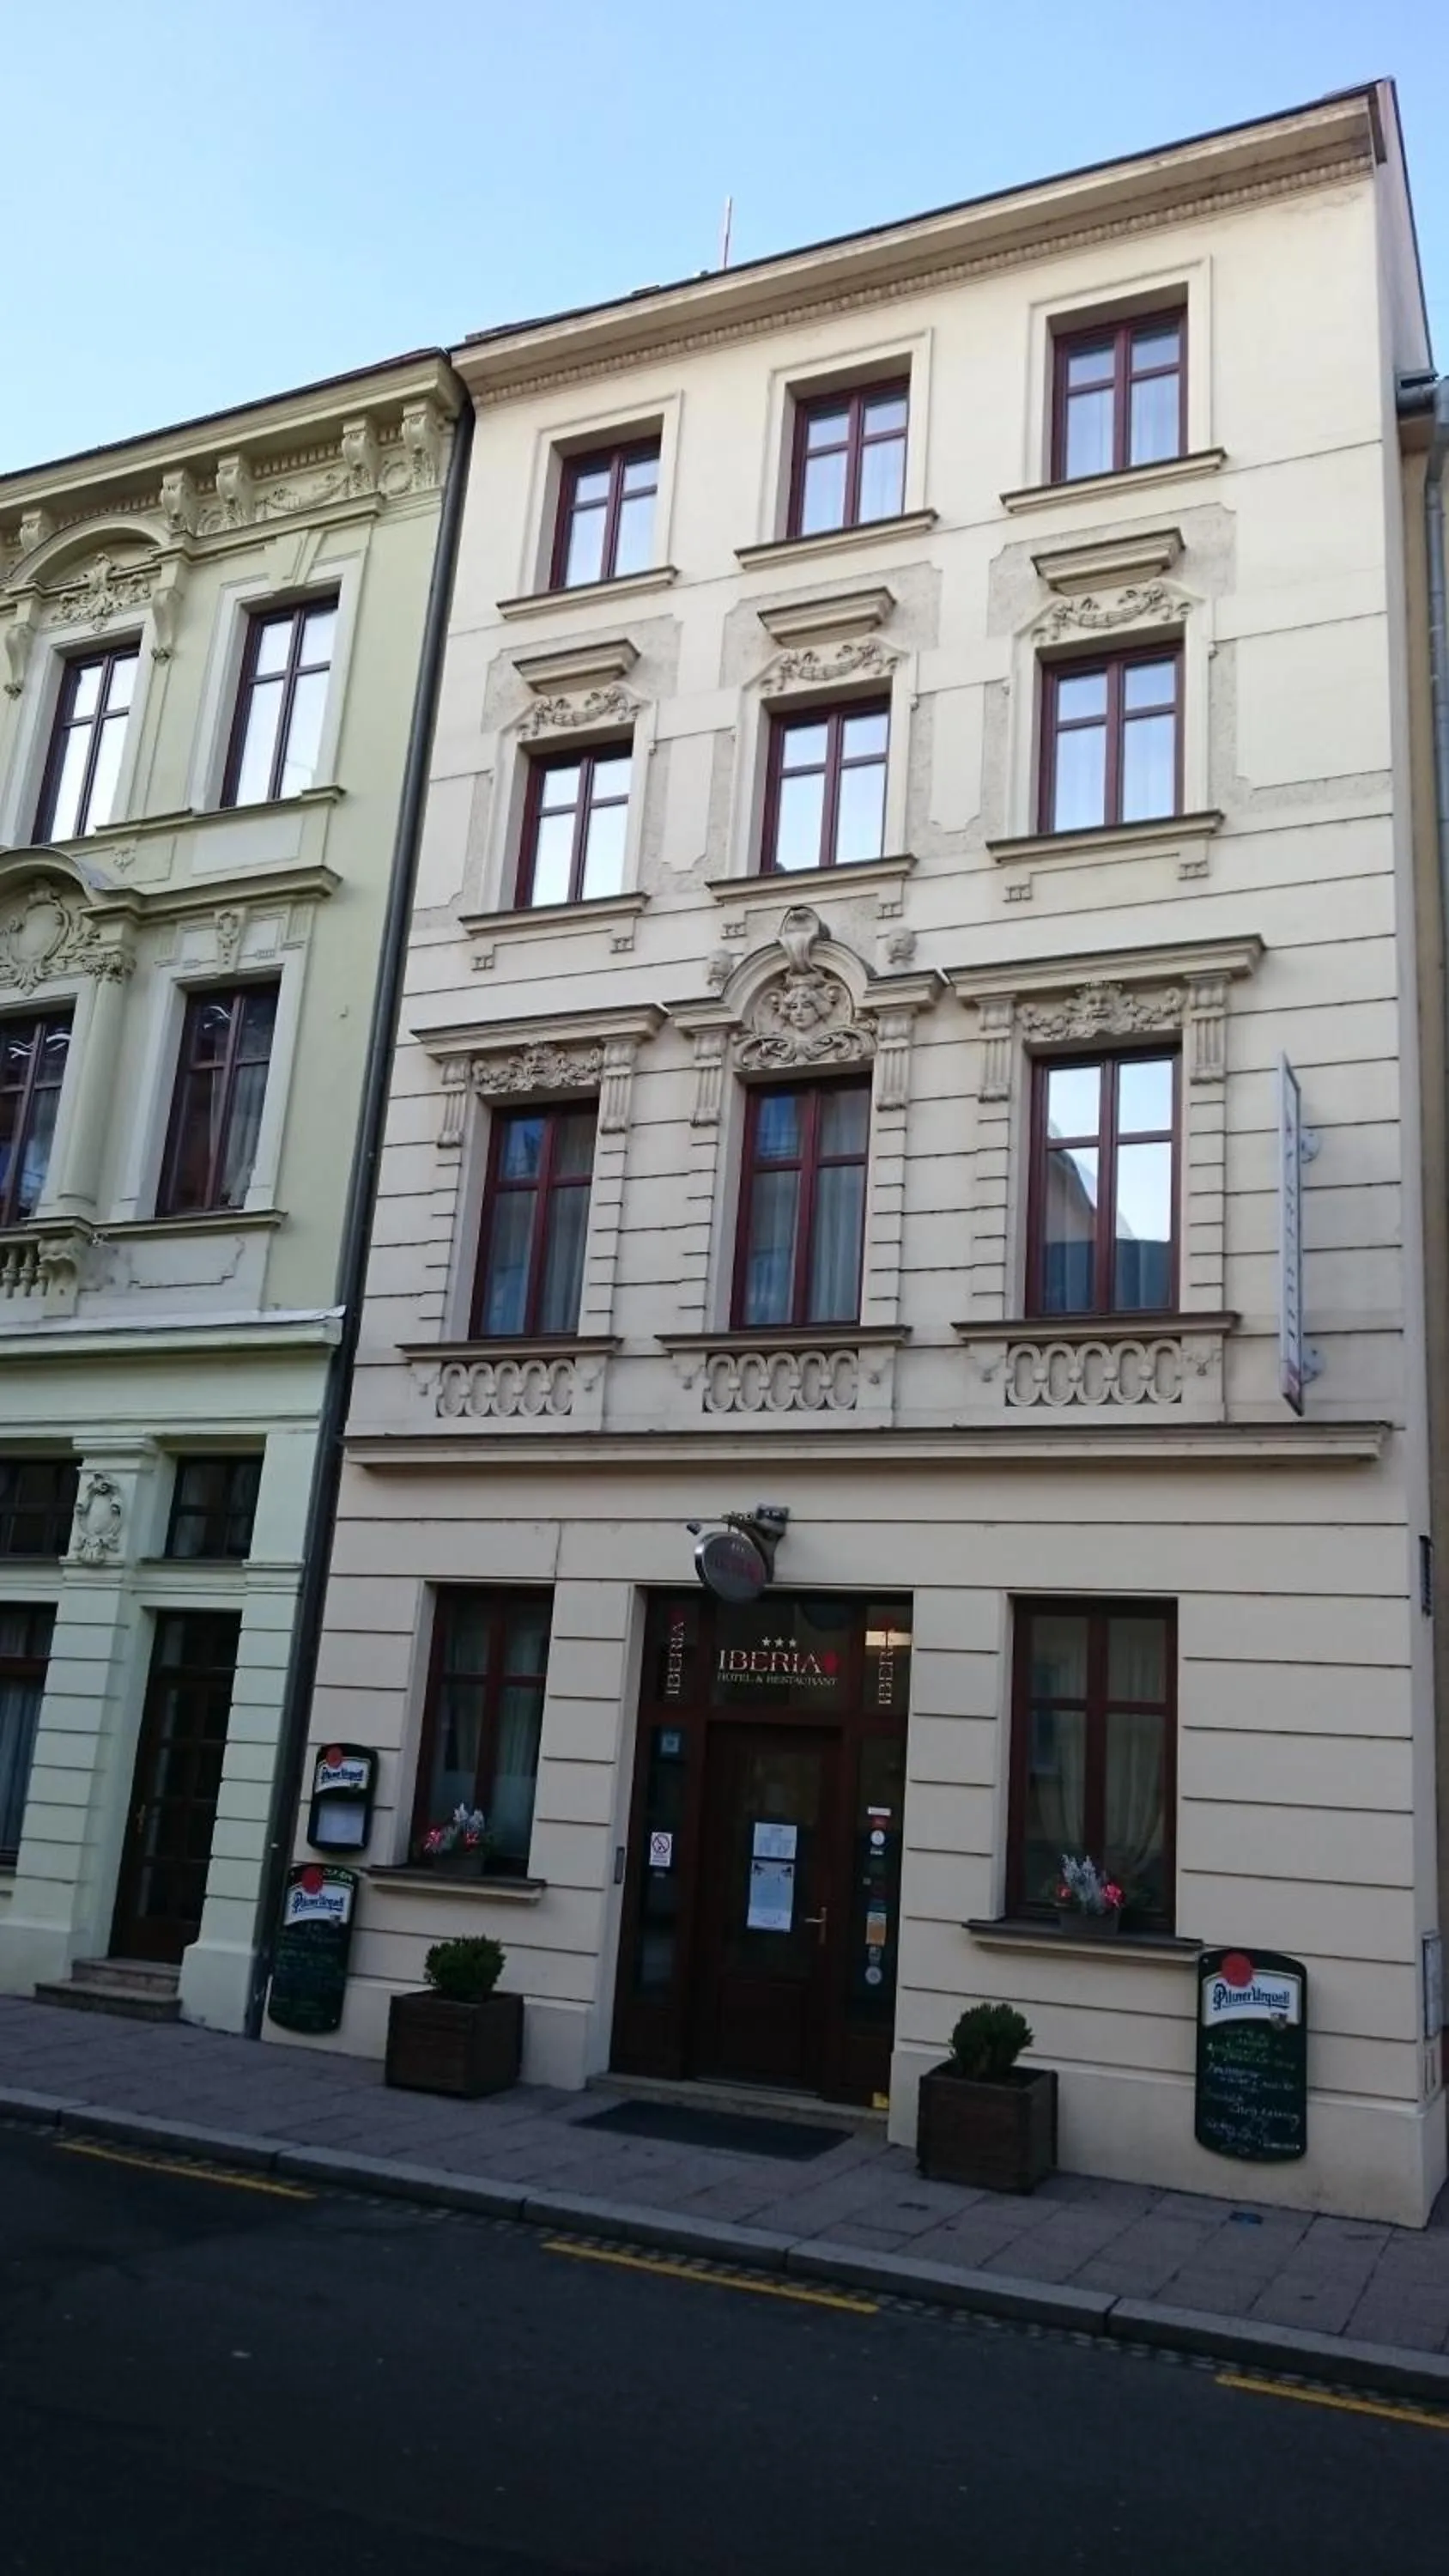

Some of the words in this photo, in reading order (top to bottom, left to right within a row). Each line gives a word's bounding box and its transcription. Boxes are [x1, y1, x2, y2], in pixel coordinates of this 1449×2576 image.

[718, 1649, 822, 1674] IBERIA
[717, 1672, 753, 1683] HOTEL
[766, 1675, 839, 1686] RESTAURANT
[1213, 1983, 1251, 2010] Pilsner
[1251, 1985, 1290, 2009] Urquell
